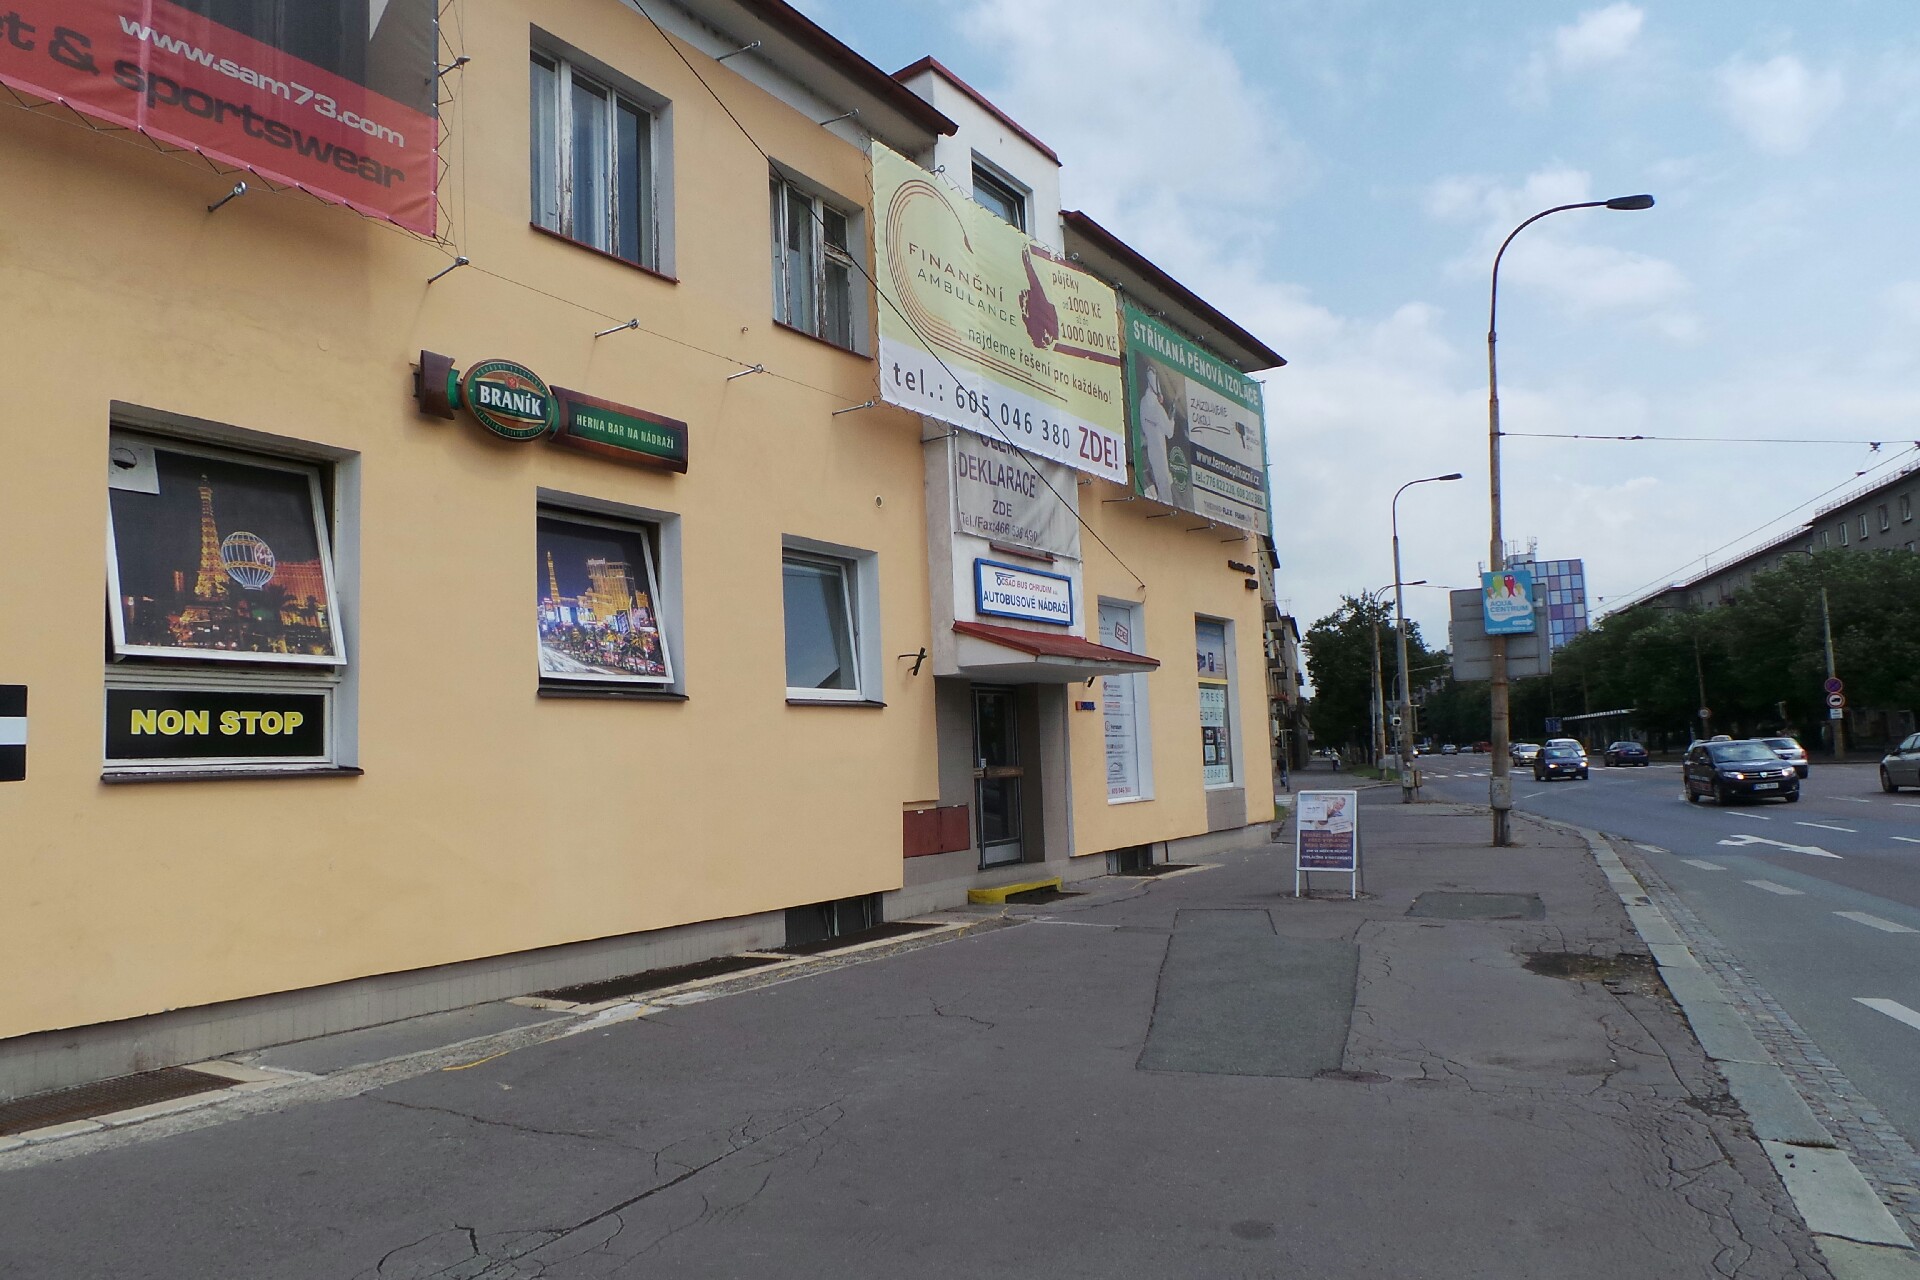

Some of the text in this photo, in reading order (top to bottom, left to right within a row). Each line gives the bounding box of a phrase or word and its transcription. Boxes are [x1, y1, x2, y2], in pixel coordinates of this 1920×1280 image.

[0, 11, 406, 189] t & sportswear
[118, 14, 405, 148] www.sam73.com
[908, 242, 1003, 302] FINANČNÍ
[1052, 270, 1079, 294] půjčky
[917, 268, 1017, 327] AMBULANCE
[1068, 296, 1090, 316] 1000
[1091, 302, 1102, 319] Kč
[1061, 323, 1117, 352] 1000 000 Kč
[968, 328, 1112, 405] najdeme řešení pro každého!
[1133, 319, 1185, 367] STŘÍKANÁ
[1225, 376, 1259, 407] IZOLACE
[576, 414, 674, 449] HERNA BAR NA NÁDRAŽÍ
[893, 362, 944, 402] tel.:
[955, 385, 991, 418] 605
[1000, 402, 1033, 435] 046
[1042, 419, 1070, 449] 380
[1078, 426, 1119, 470] ZDE!
[958, 451, 1036, 499] DEKLARACE
[992, 500, 1013, 518] ZDE
[1024, 527, 1038, 543] 490
[983, 590, 1069, 614] AUTOBUSOVÉ NÁDRAŽÍ
[130, 709, 304, 736] NON STOP
